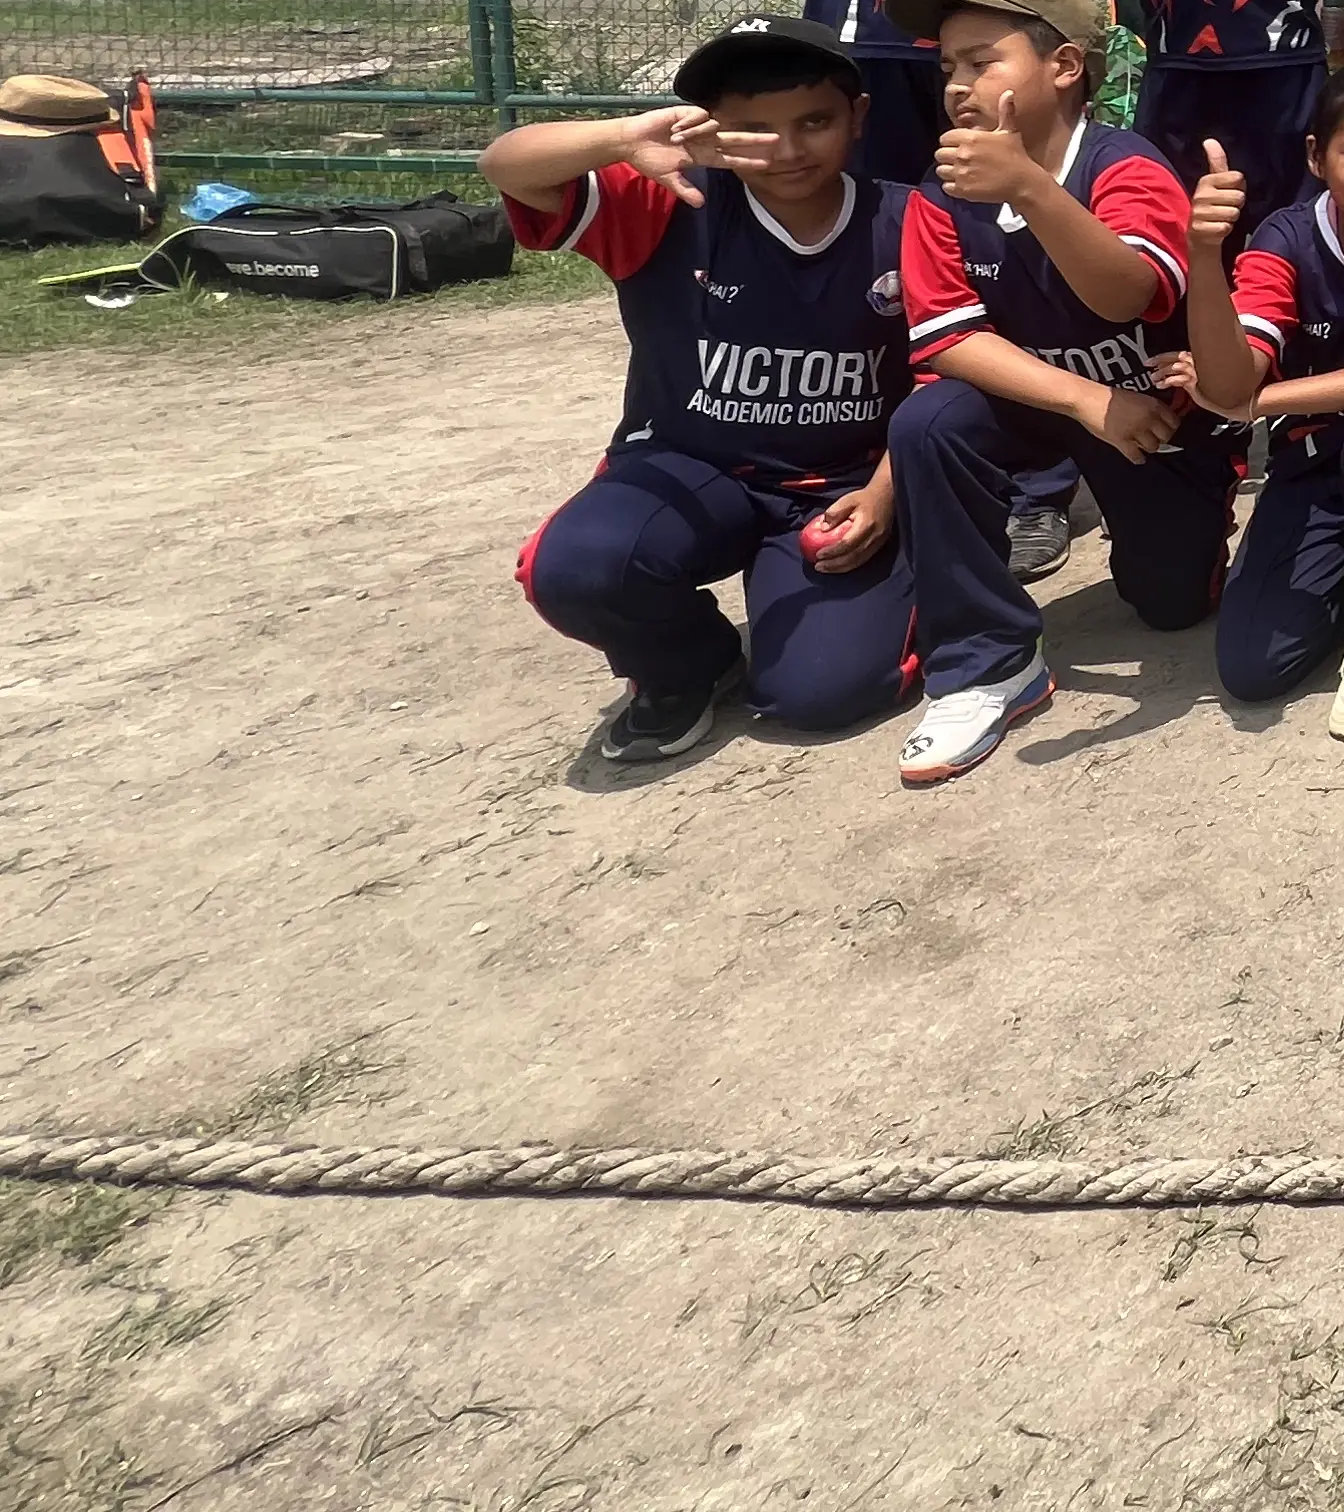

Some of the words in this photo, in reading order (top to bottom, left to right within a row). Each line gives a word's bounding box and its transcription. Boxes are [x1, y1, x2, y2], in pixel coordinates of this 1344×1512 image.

[697, 339, 887, 398] VICTORY
[686, 388, 794, 425] ACADEMIC
[797, 396, 884, 425] CONSULT
